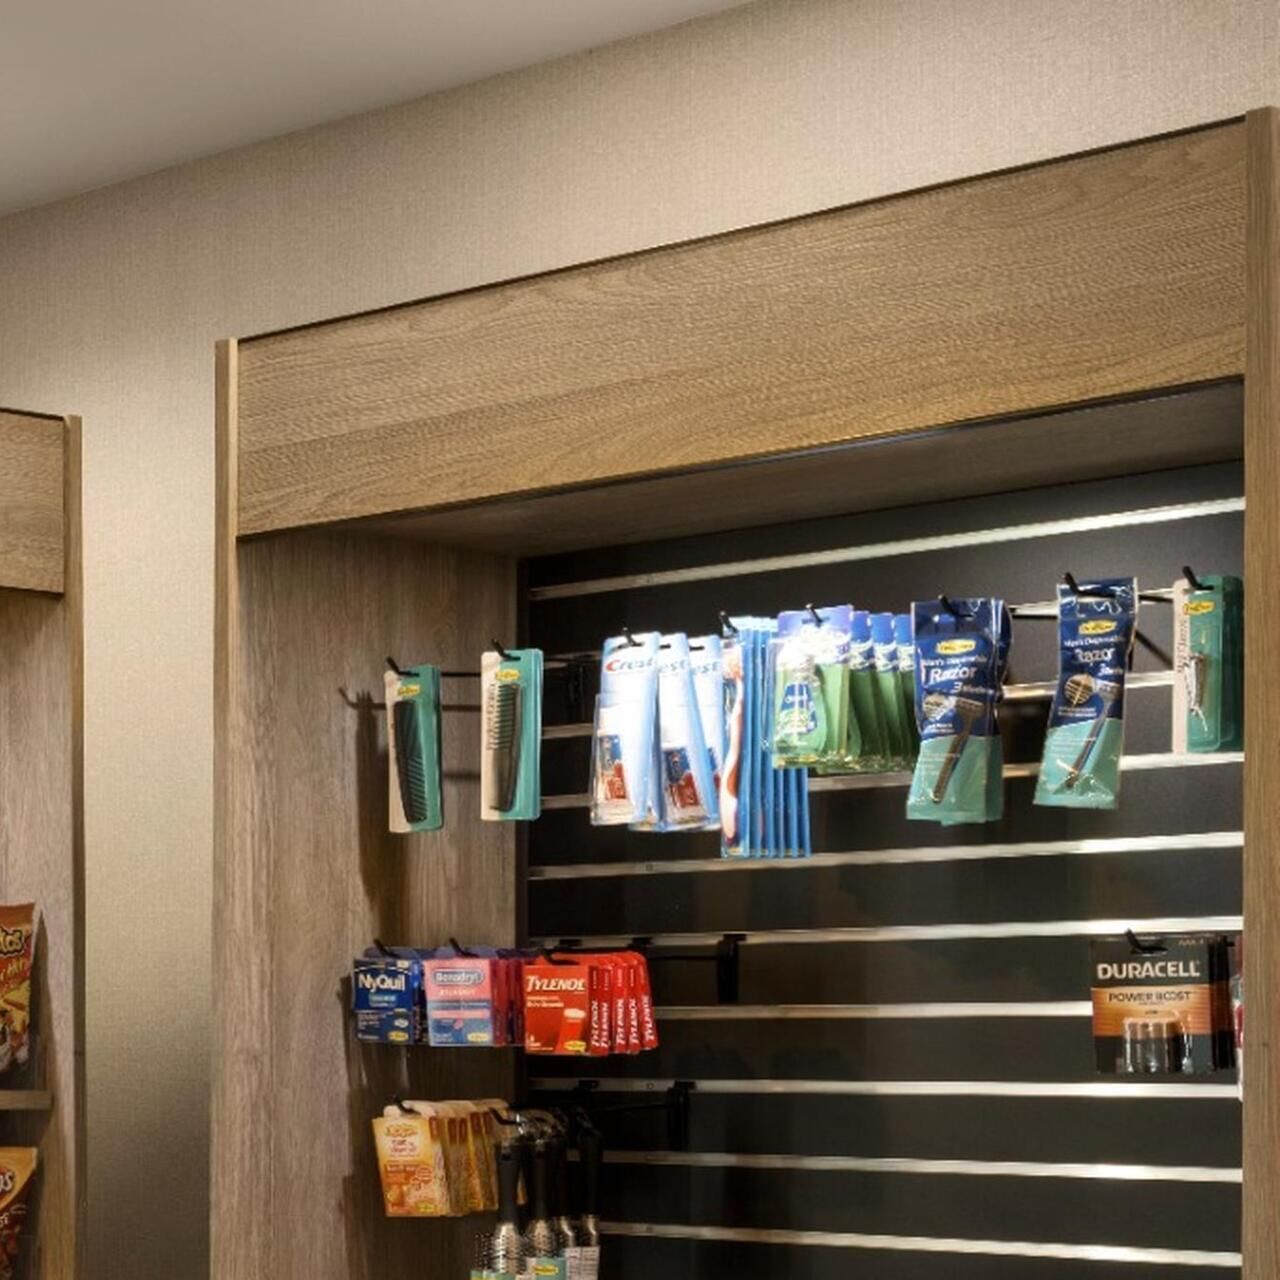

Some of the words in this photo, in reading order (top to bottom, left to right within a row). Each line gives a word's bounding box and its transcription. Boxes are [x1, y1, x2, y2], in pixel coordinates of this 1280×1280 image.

[606, 656, 657, 673] Crest
[660, 658, 690, 674] est
[689, 660, 719, 674] est
[930, 666, 978, 684] Razor
[1096, 961, 1201, 979] DURACELL
[357, 971, 406, 992] NyQuil
[526, 975, 587, 992] TYLENOL
[1108, 991, 1153, 1002] POWER
[1155, 990, 1192, 1001] BOOST
